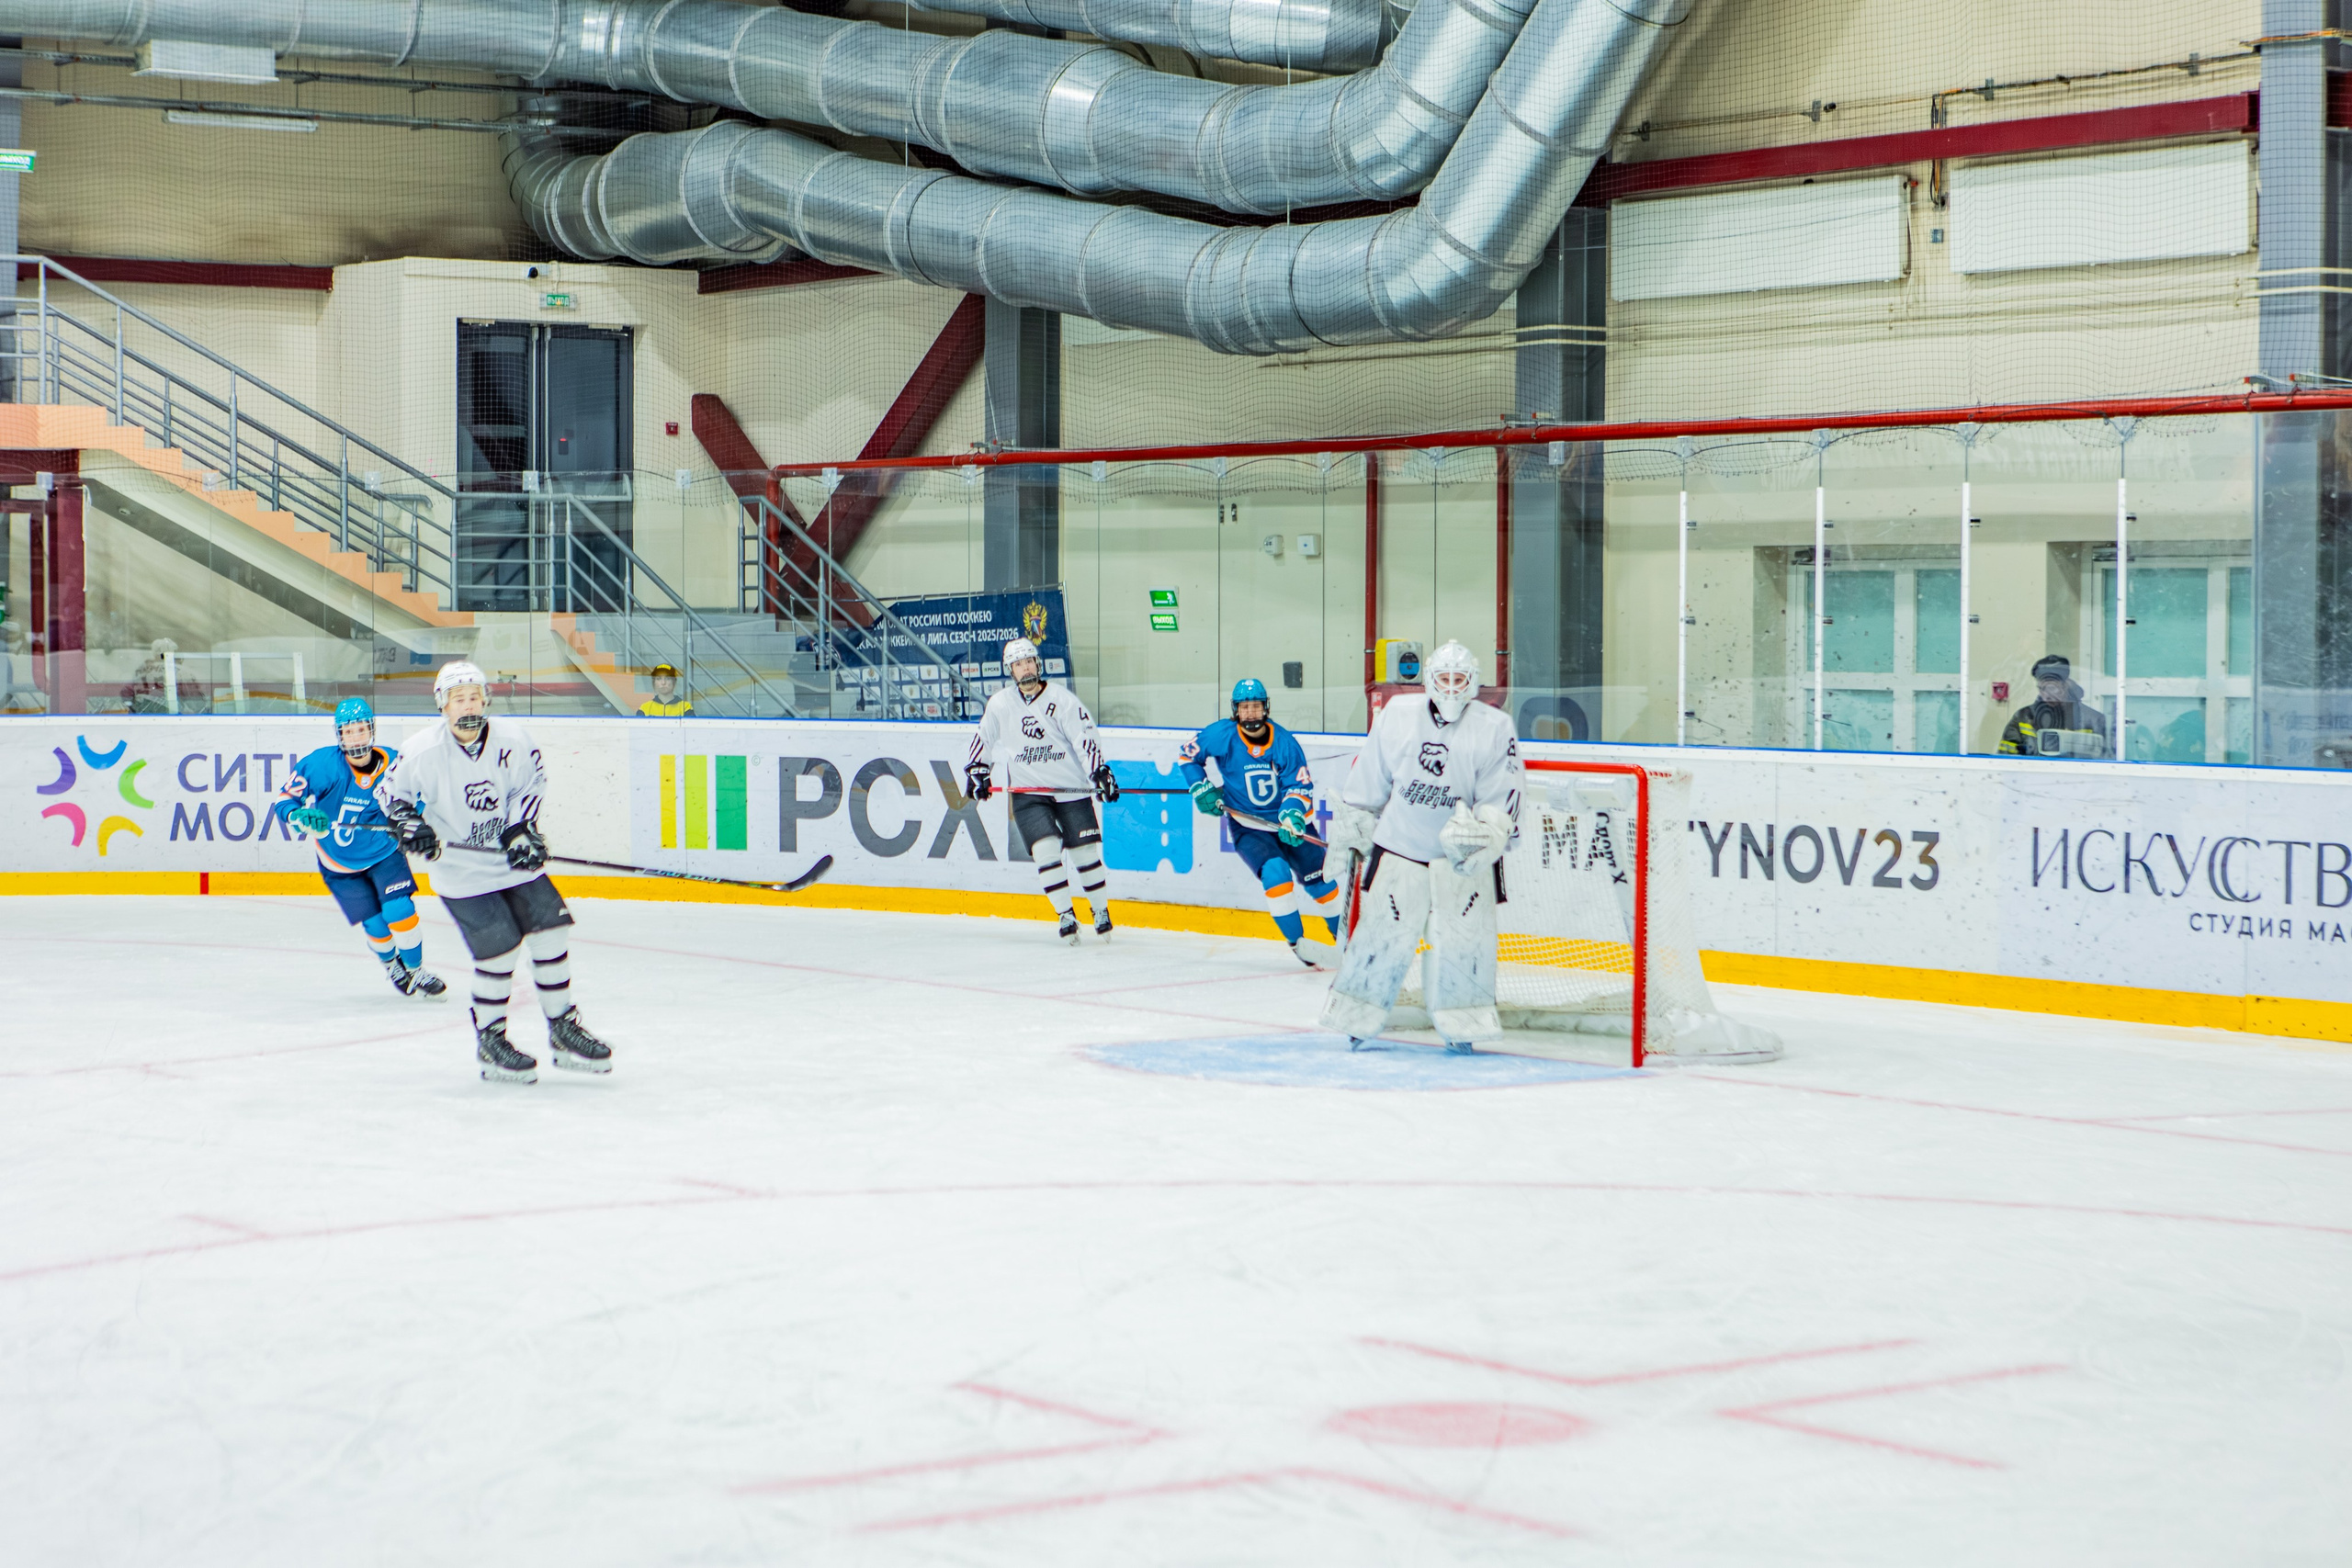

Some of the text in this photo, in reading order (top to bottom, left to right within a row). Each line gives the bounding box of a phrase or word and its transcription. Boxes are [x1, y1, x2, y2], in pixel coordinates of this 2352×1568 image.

[909, 613, 943, 627] РОССИИ
[944, 613, 956, 626] ПО
[927, 631, 948, 645] ЛИГА
[977, 627, 1019, 642] 2025/2026
[1542, 814, 1939, 891] MAYNOV23
[2189, 912, 2352, 943] СТУДИЯ МА
